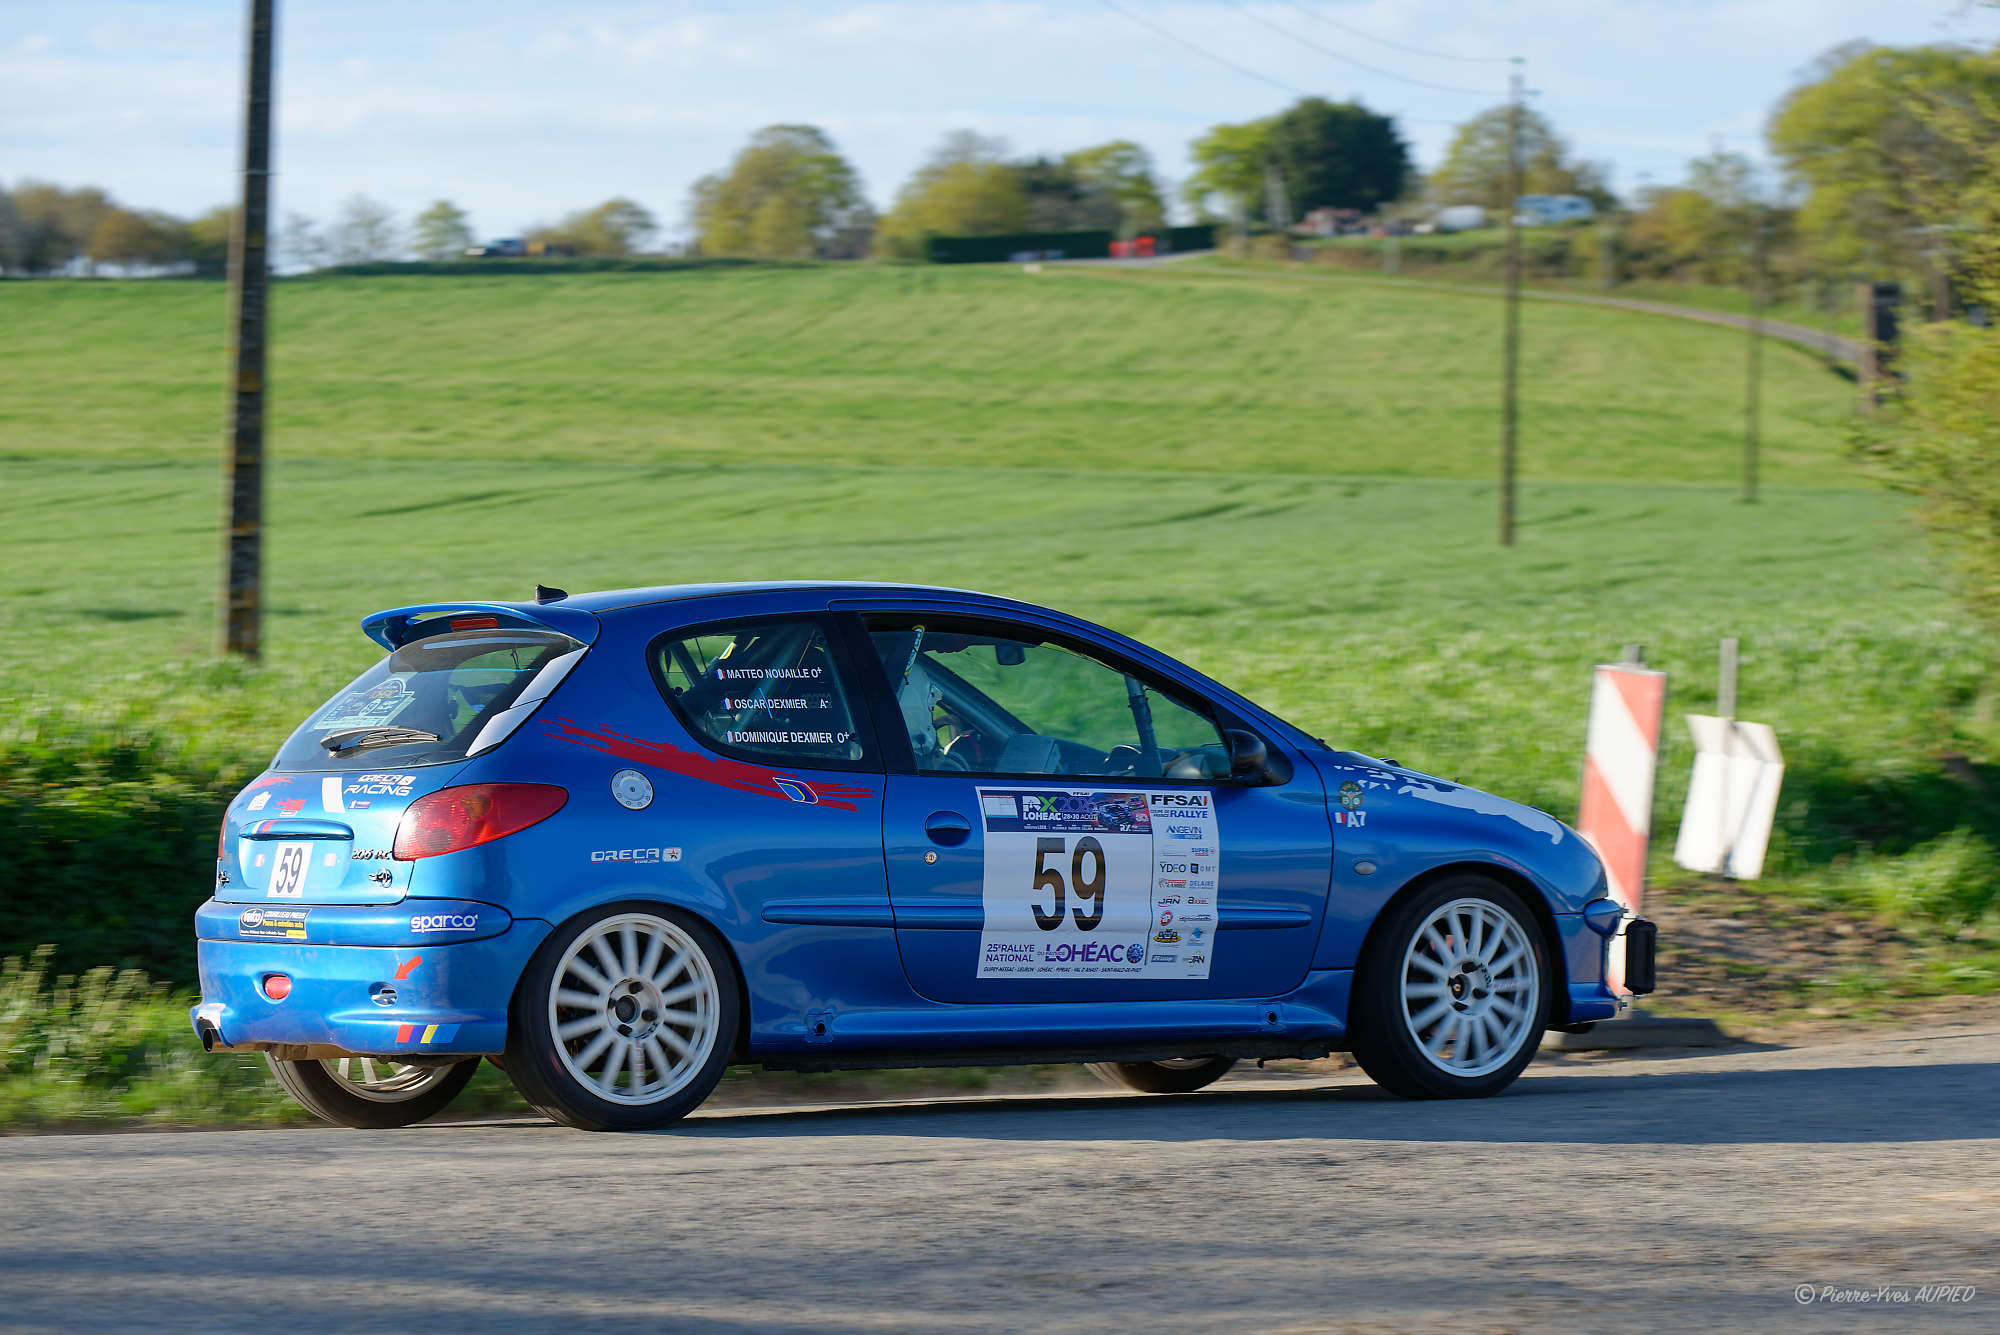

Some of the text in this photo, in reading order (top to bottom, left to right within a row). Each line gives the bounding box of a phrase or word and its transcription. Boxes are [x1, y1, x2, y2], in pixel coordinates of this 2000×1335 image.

[726, 668, 764, 679] MATTEO
[765, 668, 810, 679] NOUAILLE
[734, 698, 766, 709] OSCAR
[767, 698, 808, 709] DEXMIER
[735, 731, 789, 743] DOMINIQUE
[790, 731, 833, 743] DEXMIER
[343, 784, 413, 797] RACING
[1151, 794, 1203, 807] FFSA
[1023, 812, 1061, 821] LOHEAC
[1170, 810, 1208, 818] RALLYE
[1347, 811, 1366, 827] A7
[590, 847, 660, 862] ORECA
[276, 847, 303, 894] 59
[1031, 835, 1106, 931] 59
[410, 914, 477, 933] sparco
[1001, 943, 1035, 953] RALLYE
[1045, 941, 1125, 963] LOHÉAC
[985, 953, 1034, 962] NATIONAL
